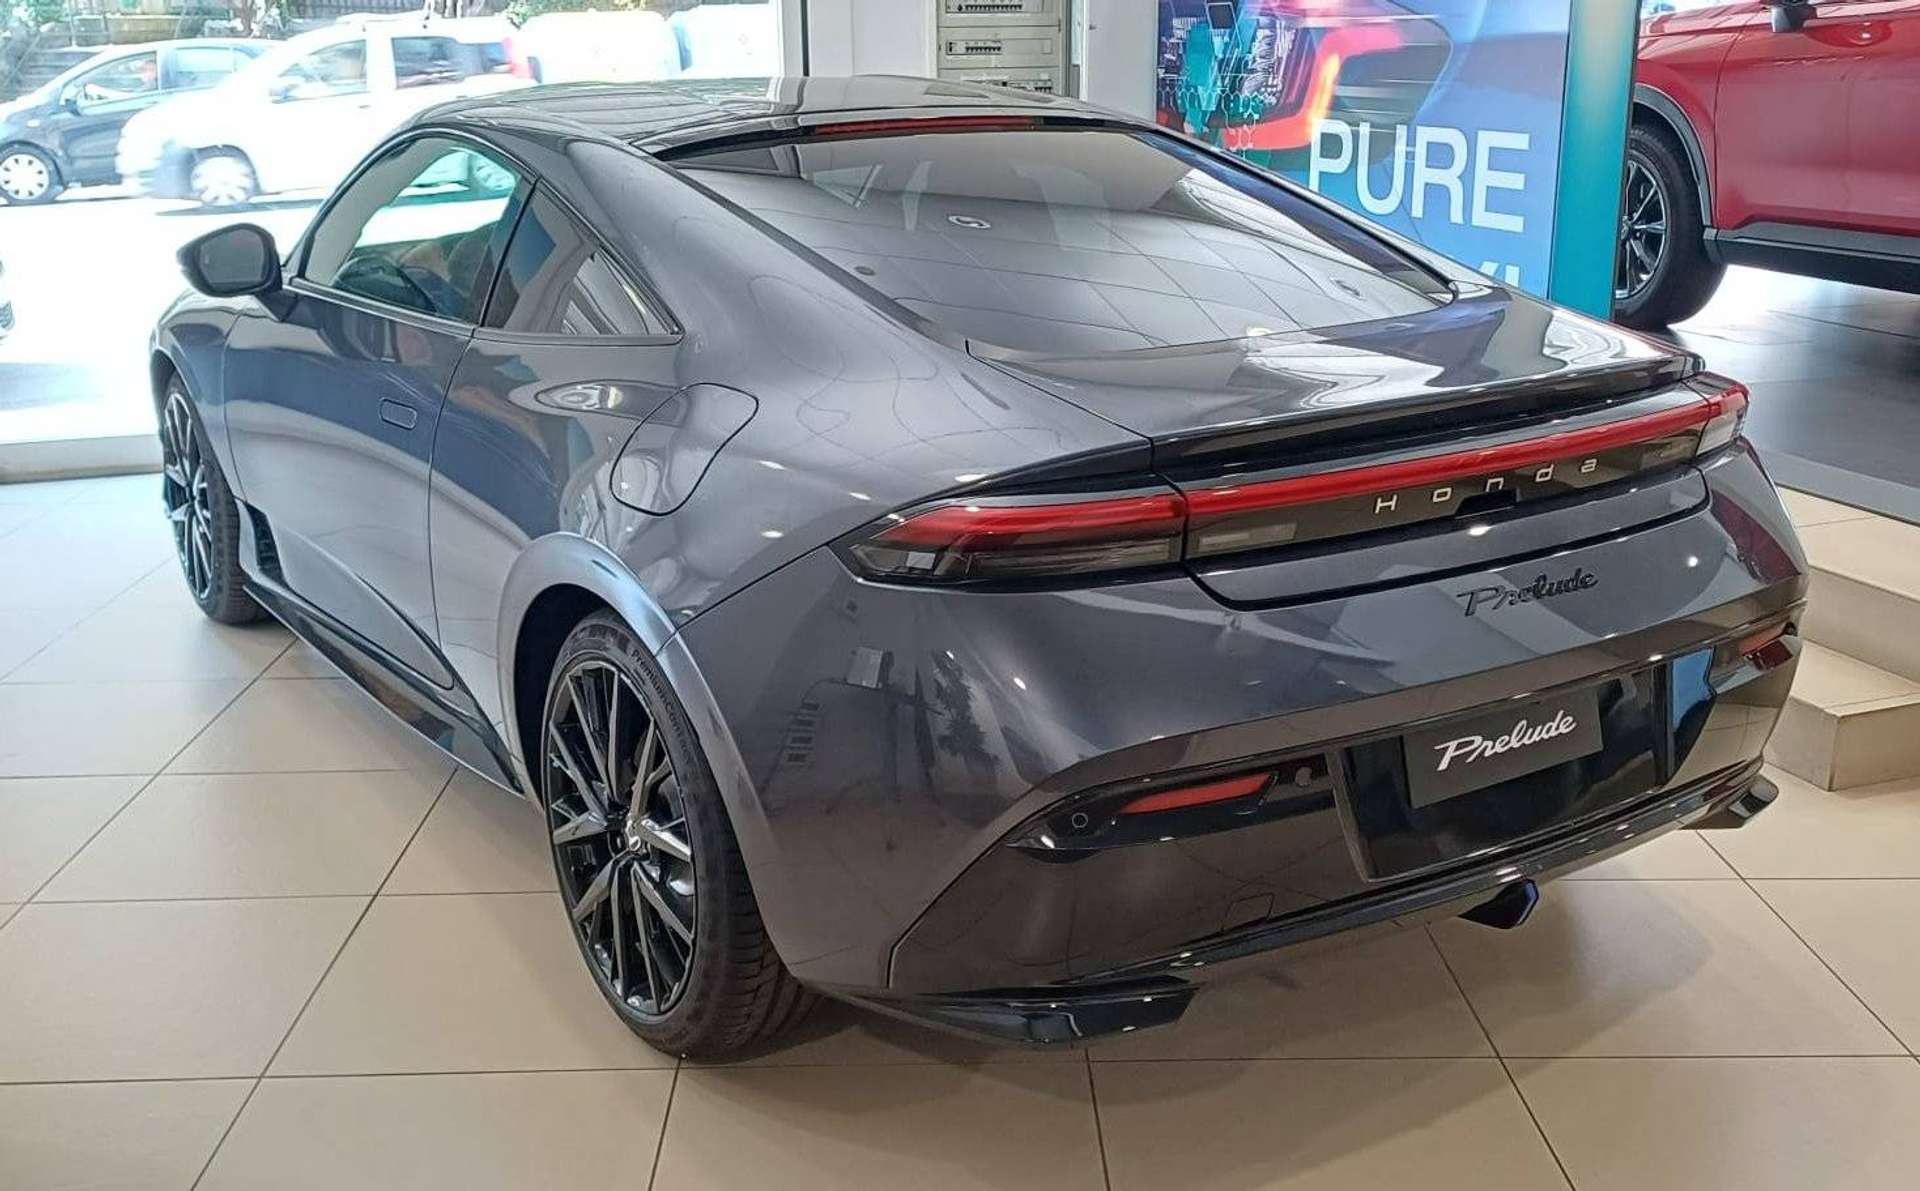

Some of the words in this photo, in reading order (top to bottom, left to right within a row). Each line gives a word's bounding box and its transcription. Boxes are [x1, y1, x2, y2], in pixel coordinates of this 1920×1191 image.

[1310, 118, 1530, 232] PURE
[1456, 567, 1599, 617] Prelude
[1434, 709, 1577, 772] Prelude
